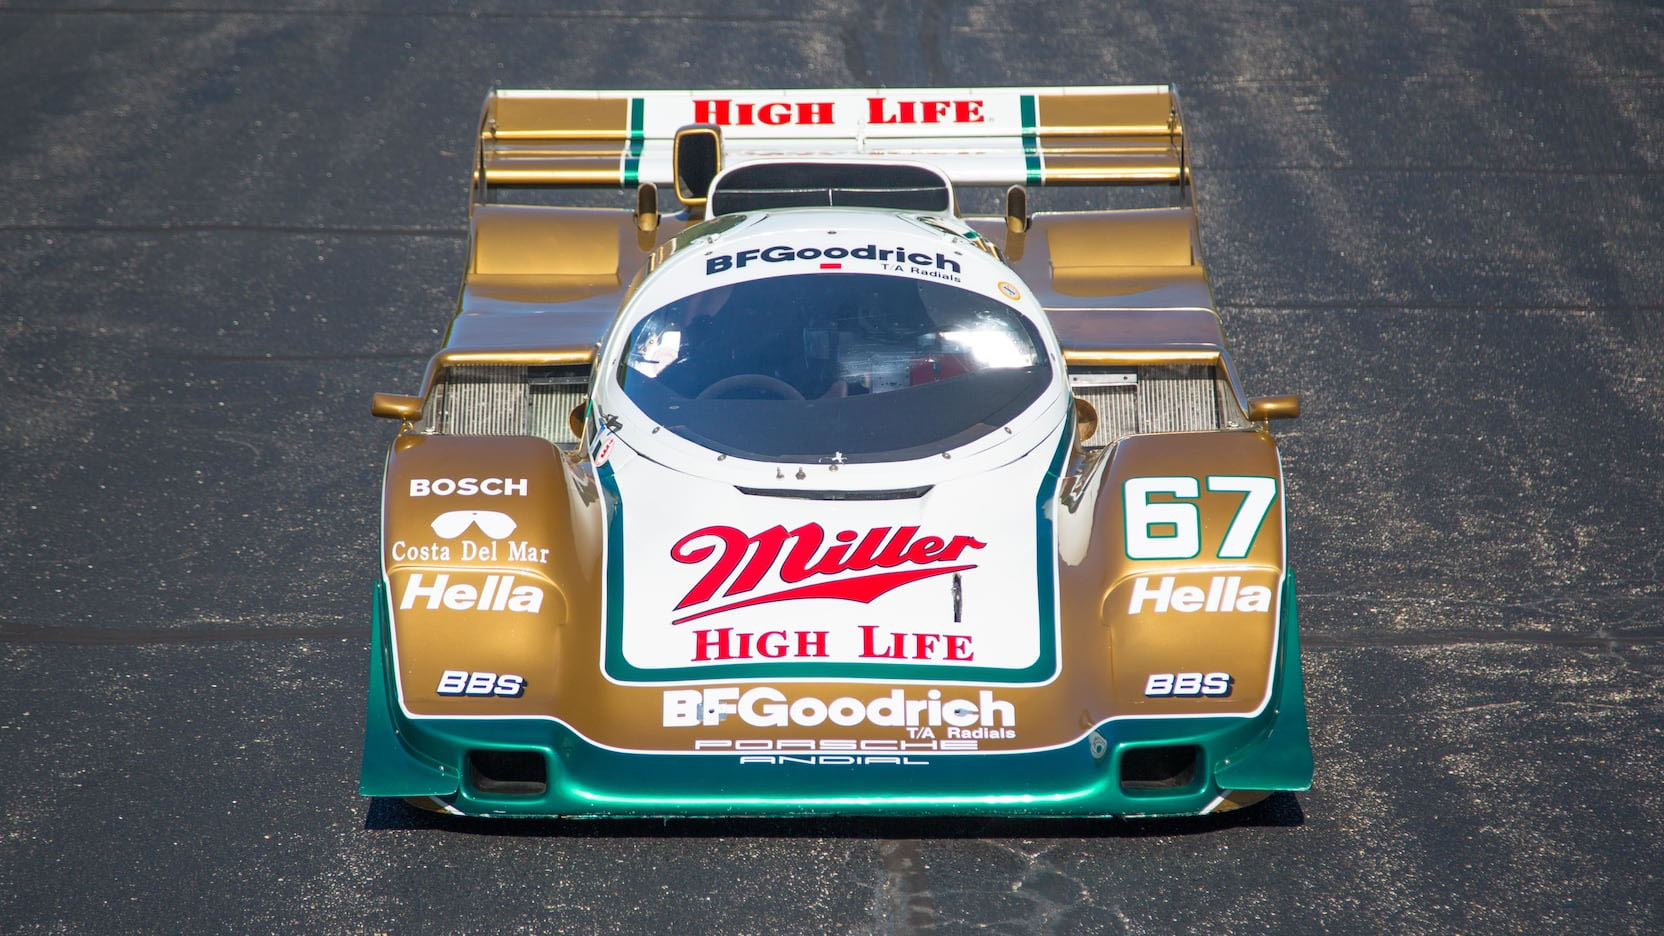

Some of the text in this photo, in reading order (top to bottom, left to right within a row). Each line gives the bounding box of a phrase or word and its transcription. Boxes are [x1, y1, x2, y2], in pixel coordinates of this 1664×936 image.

[692, 97, 985, 126] HIGH LIFE
[706, 244, 961, 275] BFGoodrich
[881, 263, 962, 283] T/A Radials
[409, 478, 528, 497] BOSCH
[1122, 475, 1278, 561] 67
[391, 541, 550, 563] Costa Del Mar
[670, 522, 988, 611] Miller
[400, 573, 544, 614] Hella
[1128, 576, 1272, 615] Hella
[690, 625, 975, 662] HIGH LIFE
[437, 670, 527, 698] BBS
[1144, 673, 1234, 698] BBS
[662, 686, 1016, 728] BFGoodrich
[694, 740, 979, 751] PORSCHE
[906, 727, 1016, 740] T/A Radials
[739, 756, 930, 765] ANDIAL
